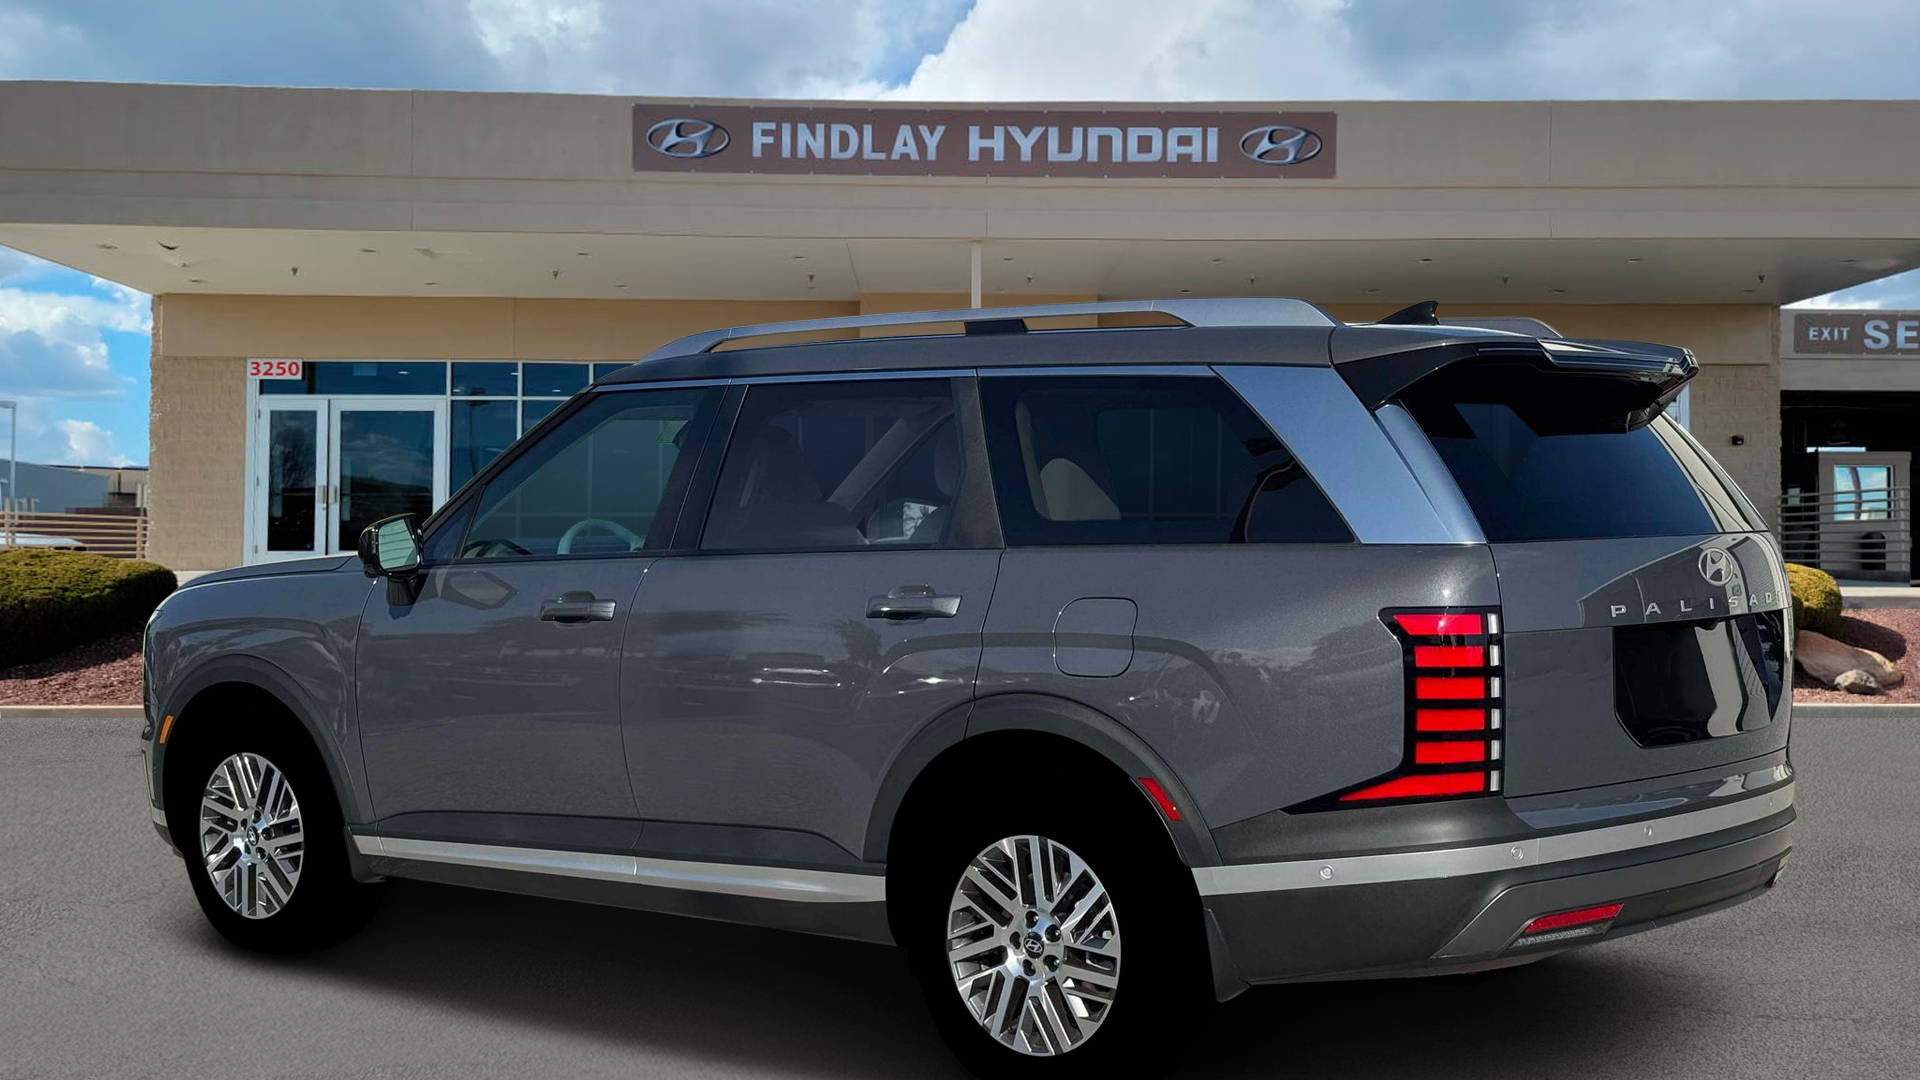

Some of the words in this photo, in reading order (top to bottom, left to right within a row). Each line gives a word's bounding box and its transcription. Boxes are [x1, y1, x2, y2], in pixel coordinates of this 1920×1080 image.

[752, 121, 946, 161] FINDLAY
[968, 125, 1219, 163] HYUNDAI
[1808, 326, 1851, 341] EXIT
[1863, 319, 1919, 350] SE
[249, 361, 300, 376] 3250
